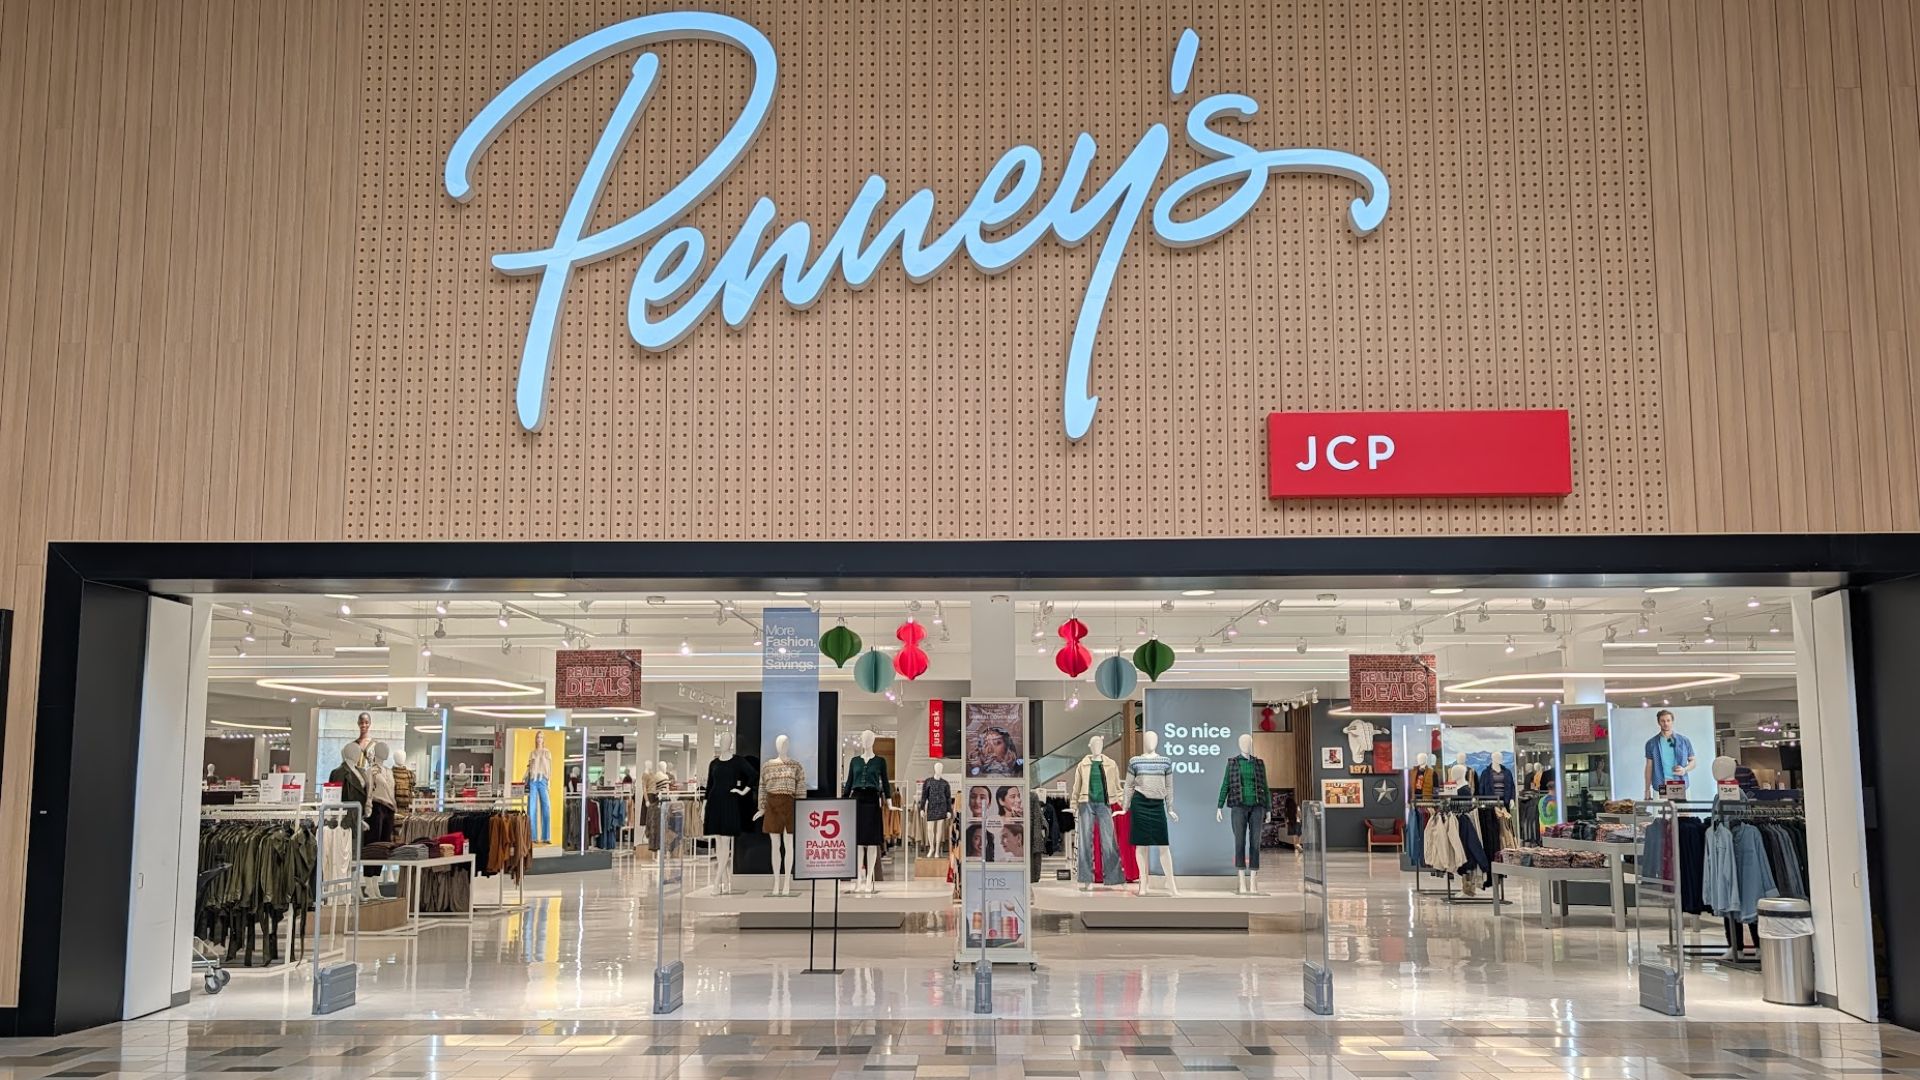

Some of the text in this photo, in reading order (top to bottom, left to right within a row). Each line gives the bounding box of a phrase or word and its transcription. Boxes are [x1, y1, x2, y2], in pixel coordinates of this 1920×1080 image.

[444, 10, 1391, 441] Penney's
[1295, 434, 1396, 471] JCP
[765, 624, 795, 636] More
[765, 635, 817, 649] Fashion,
[566, 665, 631, 678] REALLY BIG
[765, 658, 817, 672] Savings.
[1360, 671, 1426, 683] REALLY BIG
[565, 677, 631, 697] DEALS
[1360, 682, 1427, 702] DEALS
[931, 710, 942, 747] just ask
[1164, 722, 1231, 739] So nice
[1164, 741, 1221, 756] to see
[1349, 764, 1373, 775] 1971
[809, 810, 841, 840] $5
[806, 840, 846, 849] PAJAMA
[806, 848, 846, 860] PANTS
[983, 876, 1007, 888] ms
